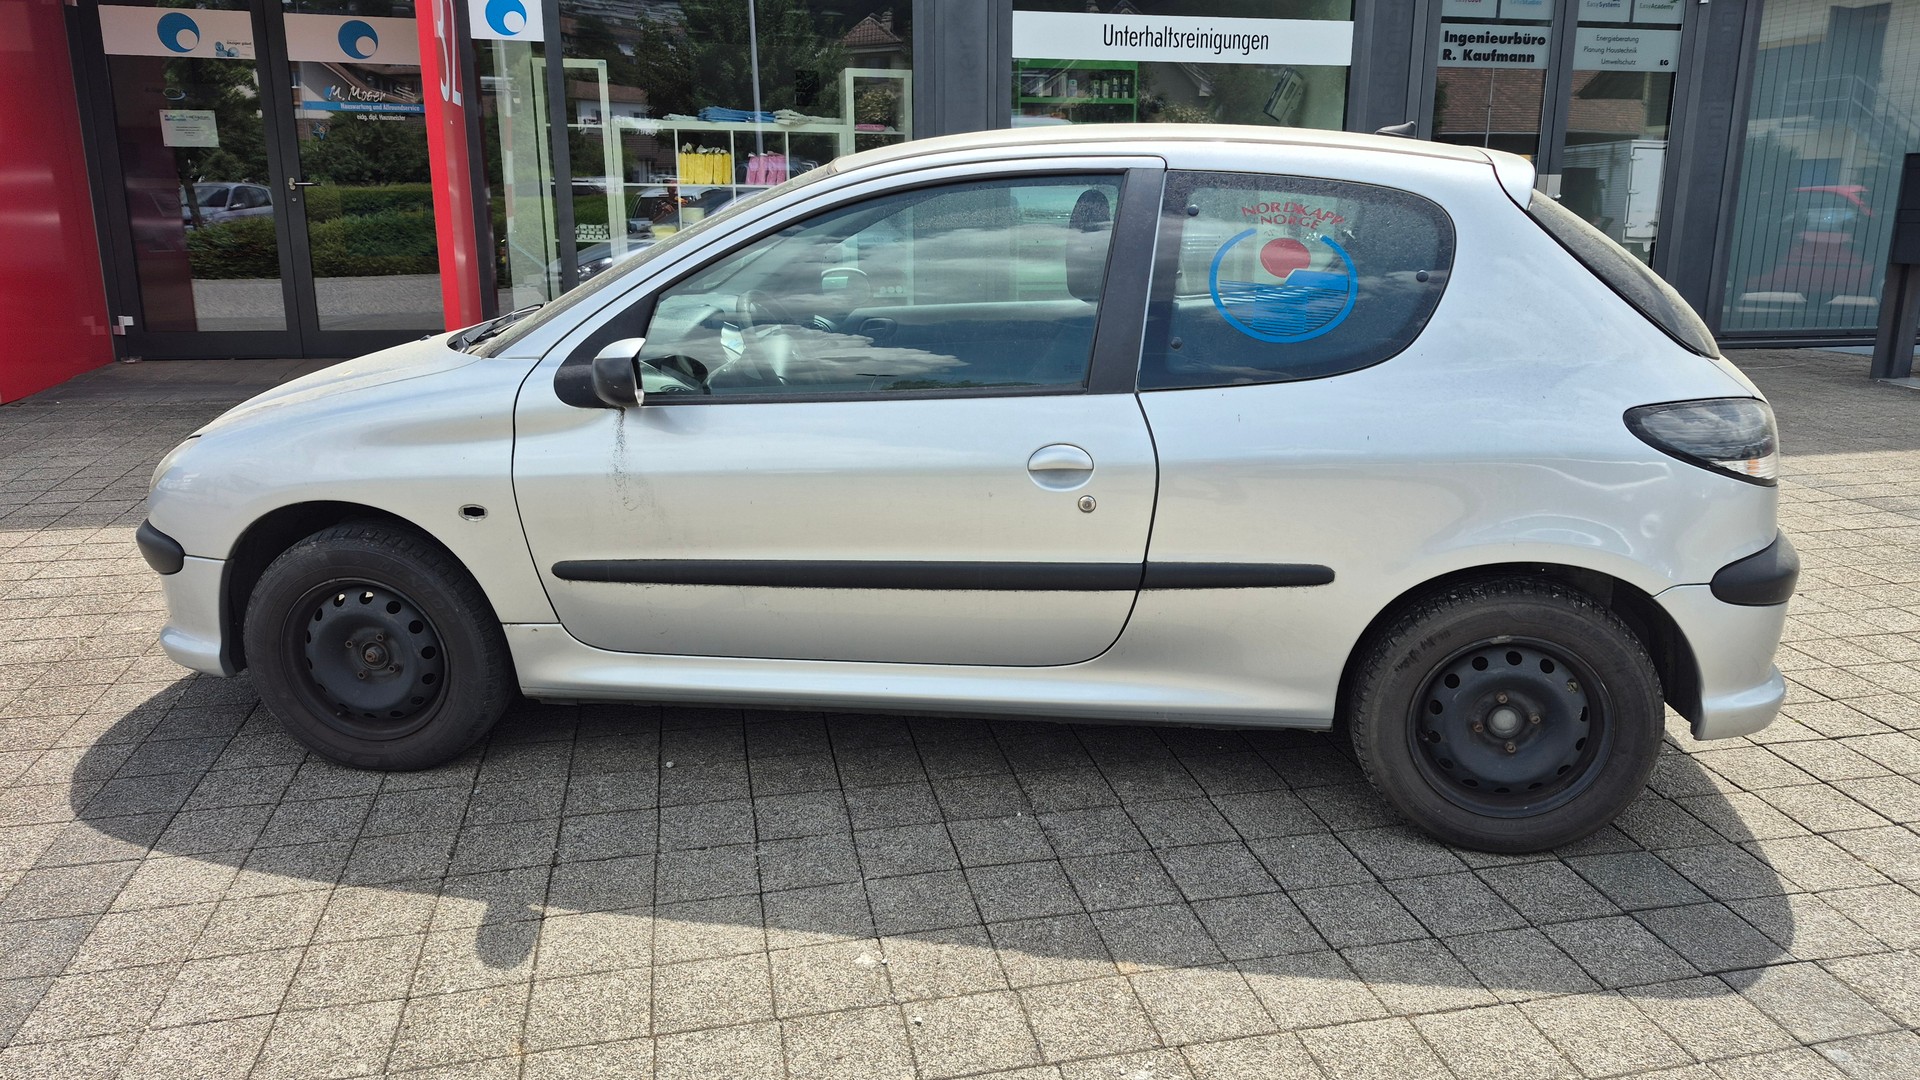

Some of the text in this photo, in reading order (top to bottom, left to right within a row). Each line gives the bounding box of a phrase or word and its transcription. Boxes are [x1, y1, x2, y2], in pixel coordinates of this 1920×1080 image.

[1102, 23, 1270, 56] Unterhaltsreinigungen
[1443, 30, 1547, 47] Ingenieurbüro
[1596, 34, 1640, 44] Energieberatung
[1442, 48, 1536, 63] R. Kaufmann
[1583, 46, 1638, 55] Planung Haustechnik
[1601, 58, 1637, 66] Umweltschutz
[328, 85, 386, 101] M. Moser
[340, 103, 372, 111] Hauswartung
[383, 104, 420, 112] Allroundservice
[1241, 202, 1345, 226] NORDKAPP
[1260, 214, 1322, 230] NORGE
